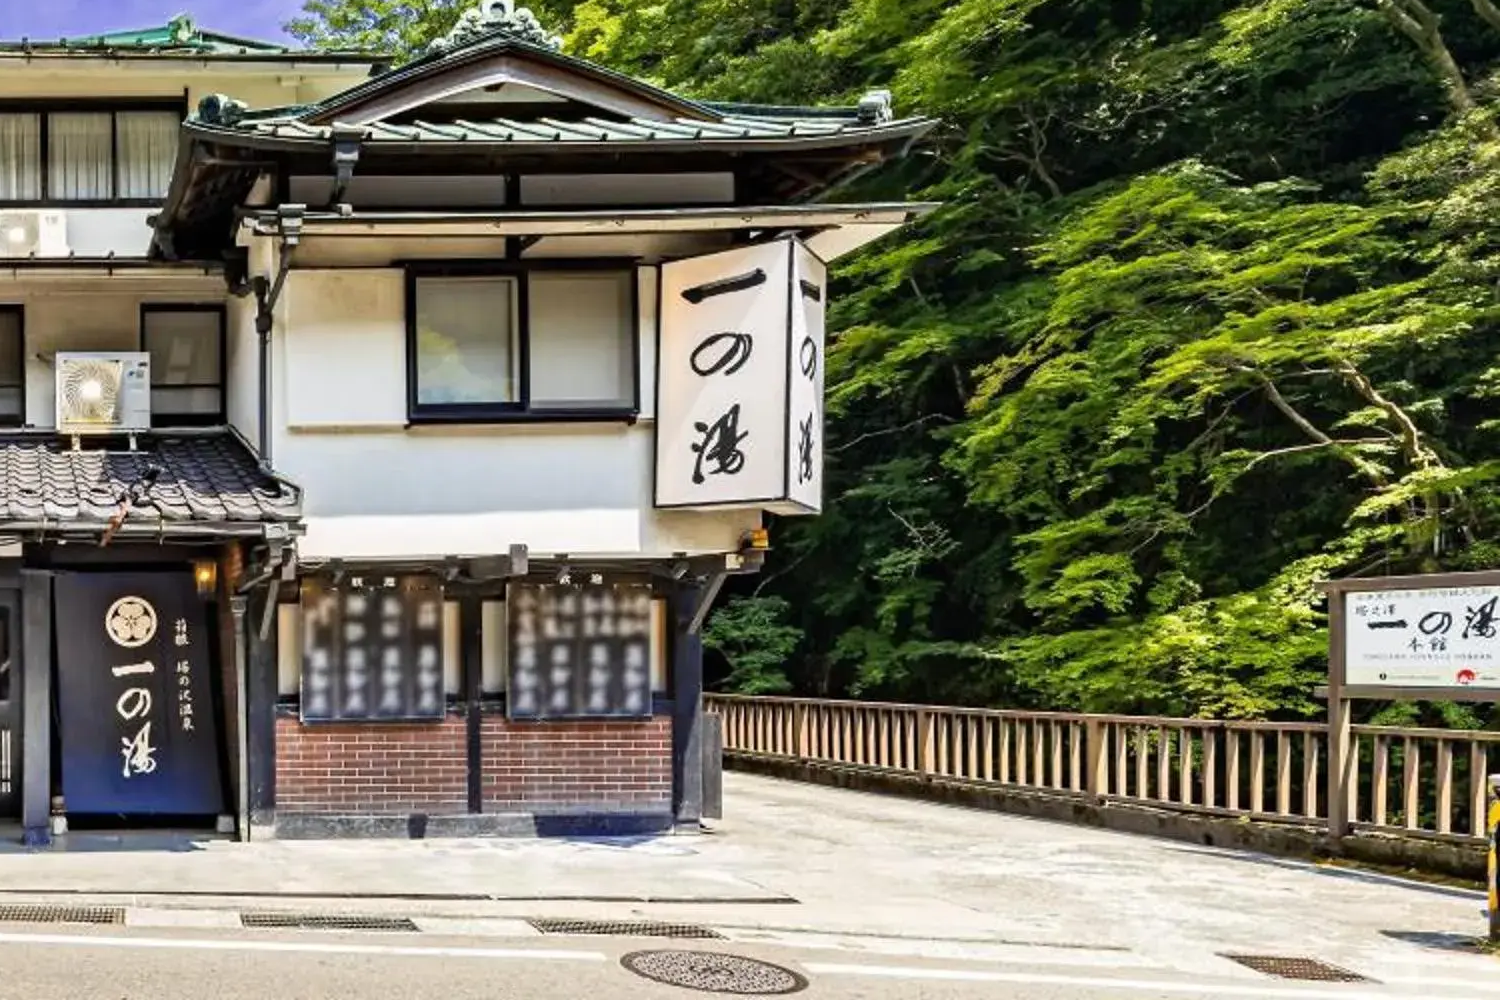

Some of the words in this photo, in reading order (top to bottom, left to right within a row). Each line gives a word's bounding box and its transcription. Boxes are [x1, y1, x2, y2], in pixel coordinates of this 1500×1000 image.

[680, 267, 768, 485] 一の湯
[798, 278, 821, 484] 一の湯
[1368, 596, 1500, 639] 一の湯
[112, 660, 156, 778] 一の湯
